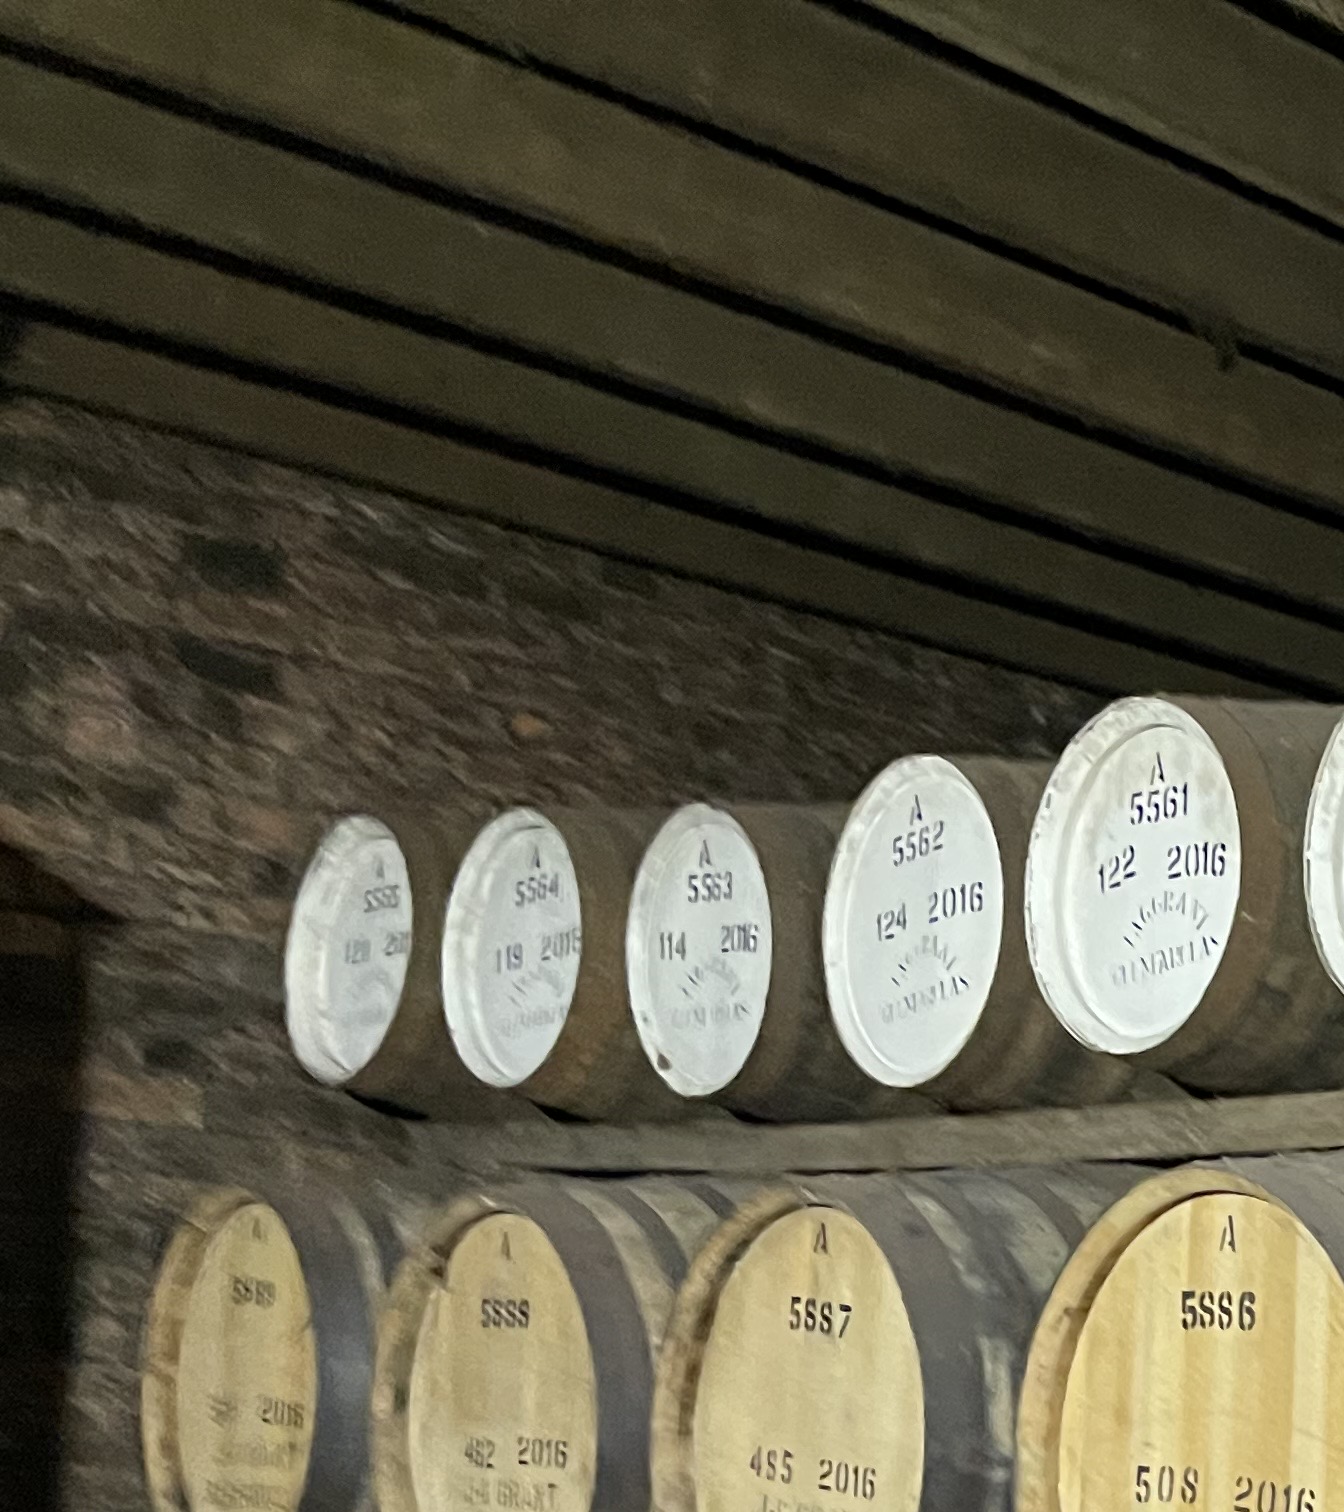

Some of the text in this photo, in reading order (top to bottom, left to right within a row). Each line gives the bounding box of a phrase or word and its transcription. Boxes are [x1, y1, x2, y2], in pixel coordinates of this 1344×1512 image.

[1149, 752, 1165, 785] A
[909, 794, 923, 826] A
[1130, 782, 1188, 825] 5561
[699, 839, 712, 868] A
[893, 820, 945, 867] 5562
[687, 871, 732, 903] 5563
[1099, 842, 1226, 894] 122 2016
[515, 873, 560, 908] 5564
[877, 881, 984, 942] 124 2016
[496, 943, 524, 975] 119
[659, 923, 759, 961] 114 2016
[813, 1222, 829, 1255] A
[1219, 1214, 1237, 1253] A
[789, 1296, 853, 1338] 5887
[1181, 1291, 1256, 1332] 5886
[517, 1436, 570, 1470] 2016
[818, 1459, 877, 1500] 2016
